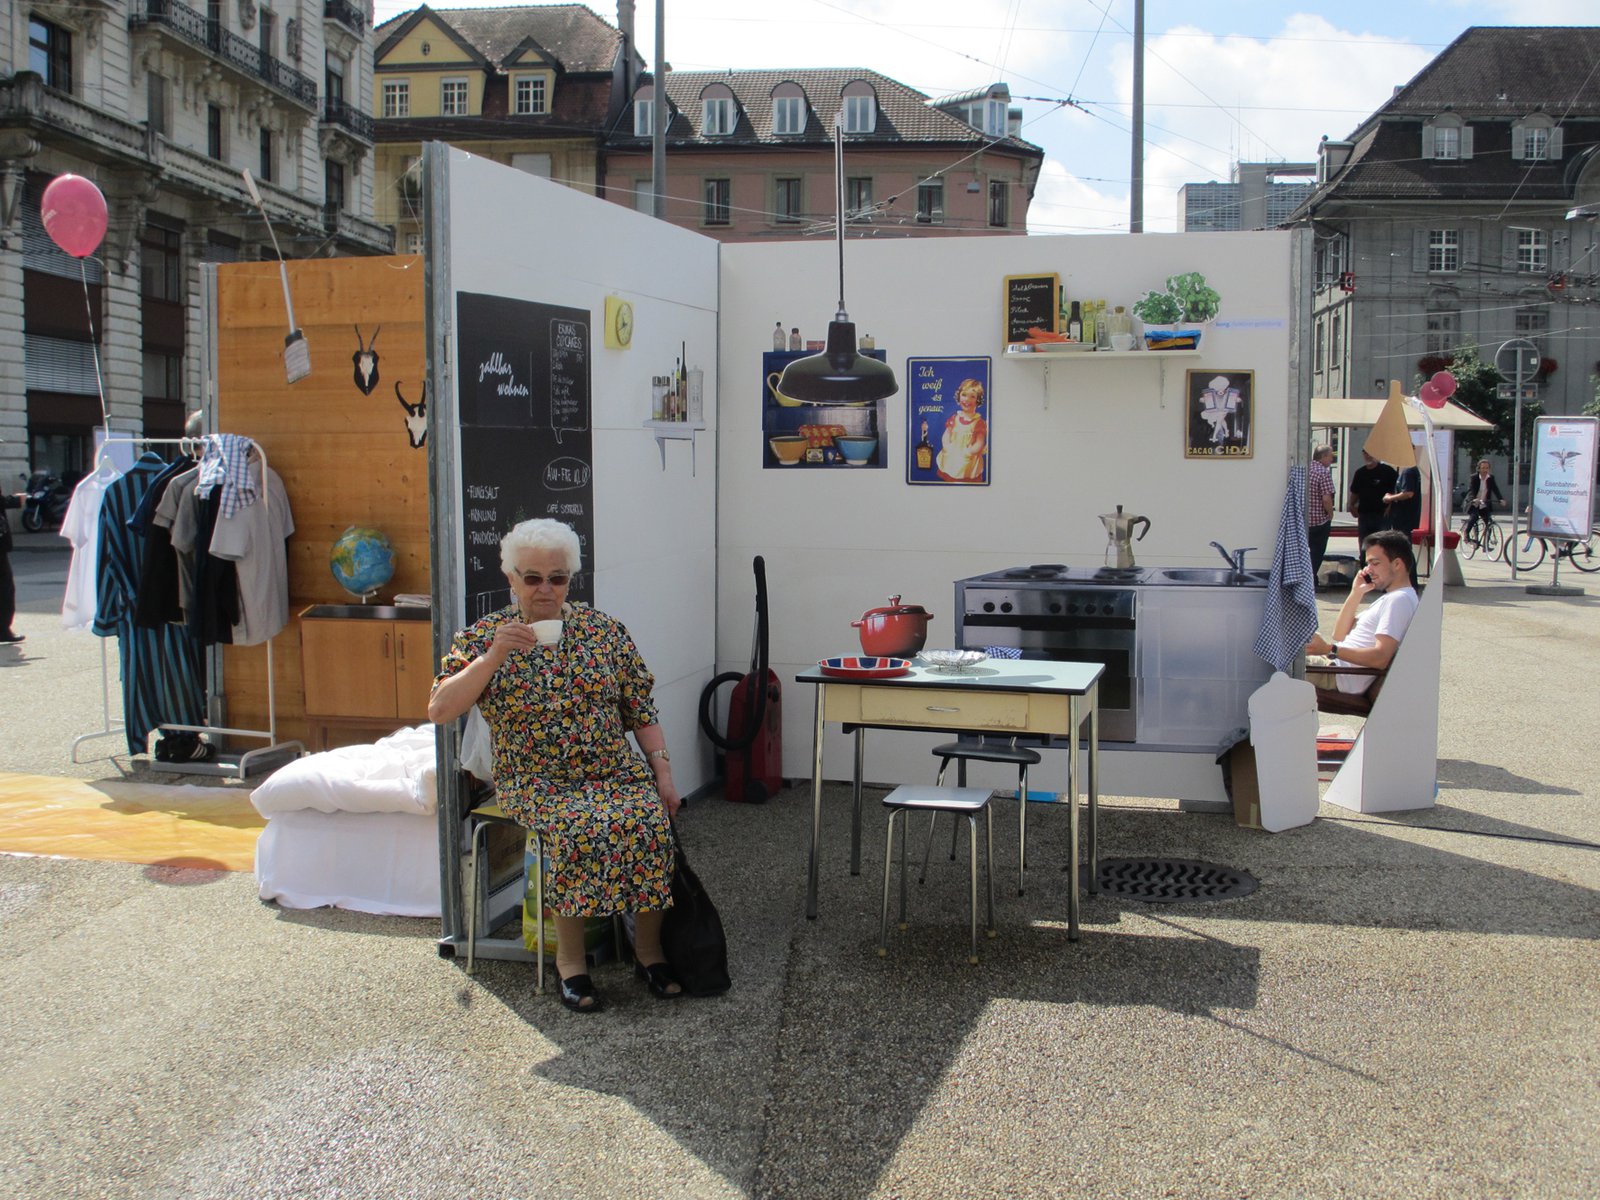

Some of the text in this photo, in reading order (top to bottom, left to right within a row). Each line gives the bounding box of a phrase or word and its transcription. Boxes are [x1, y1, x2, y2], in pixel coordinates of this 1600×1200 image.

[918, 366, 935, 377] Ich
[497, 374, 530, 397] wohnen
[1187, 445, 1250, 456] CACAO CIDA
